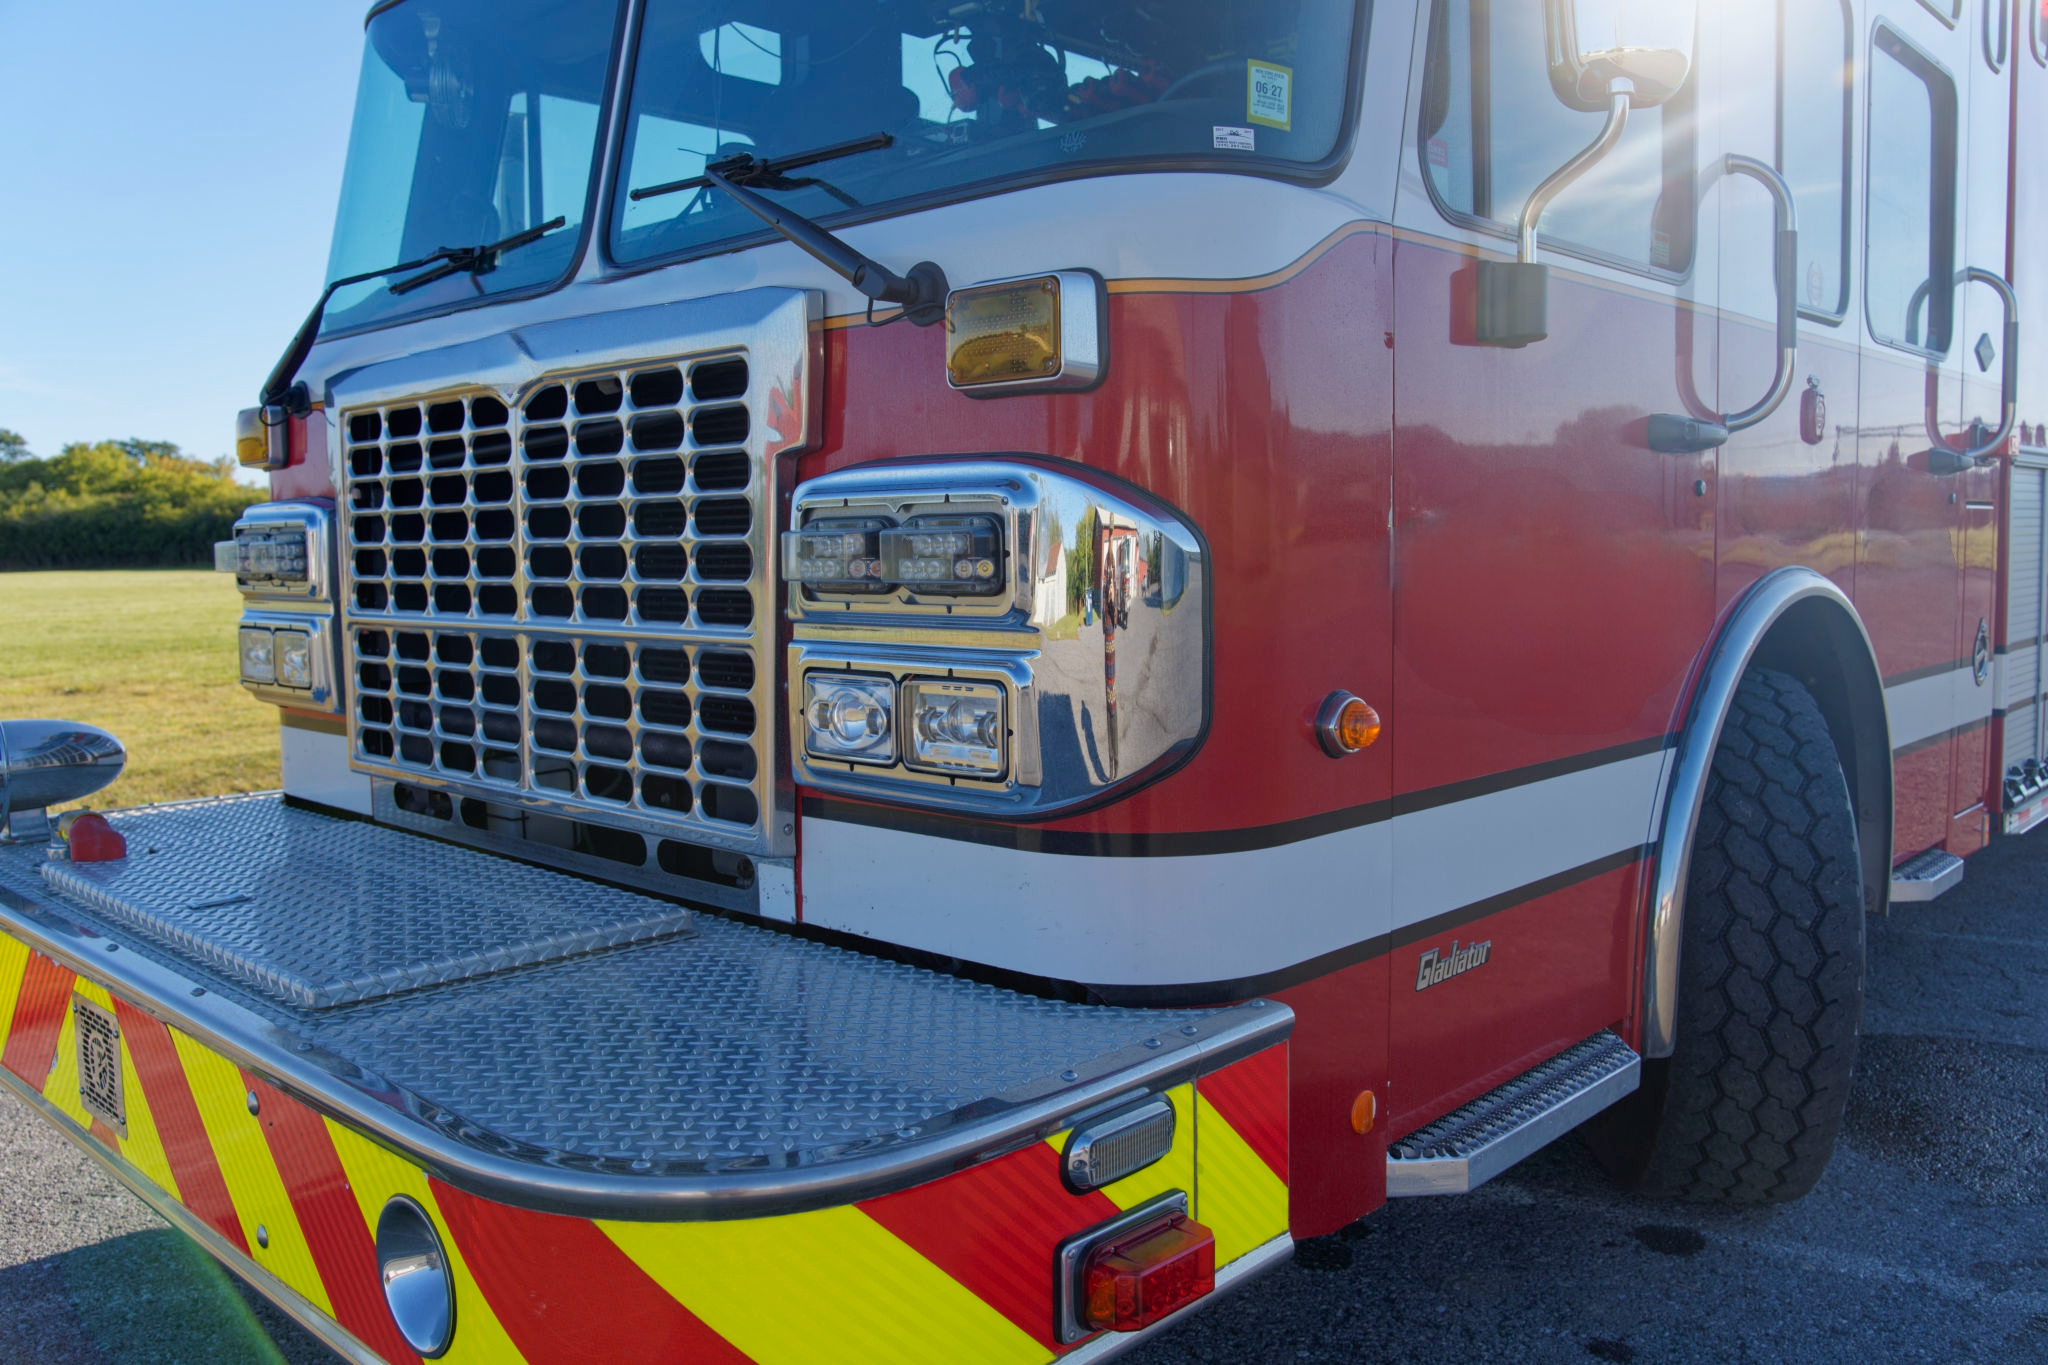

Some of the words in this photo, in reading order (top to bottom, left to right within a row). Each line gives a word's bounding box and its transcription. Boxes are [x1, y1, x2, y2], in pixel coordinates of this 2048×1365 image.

[1256, 81, 1268, 94] 06
[1272, 85, 1283, 98] 27
[1415, 940, 1491, 992] Gladiator
